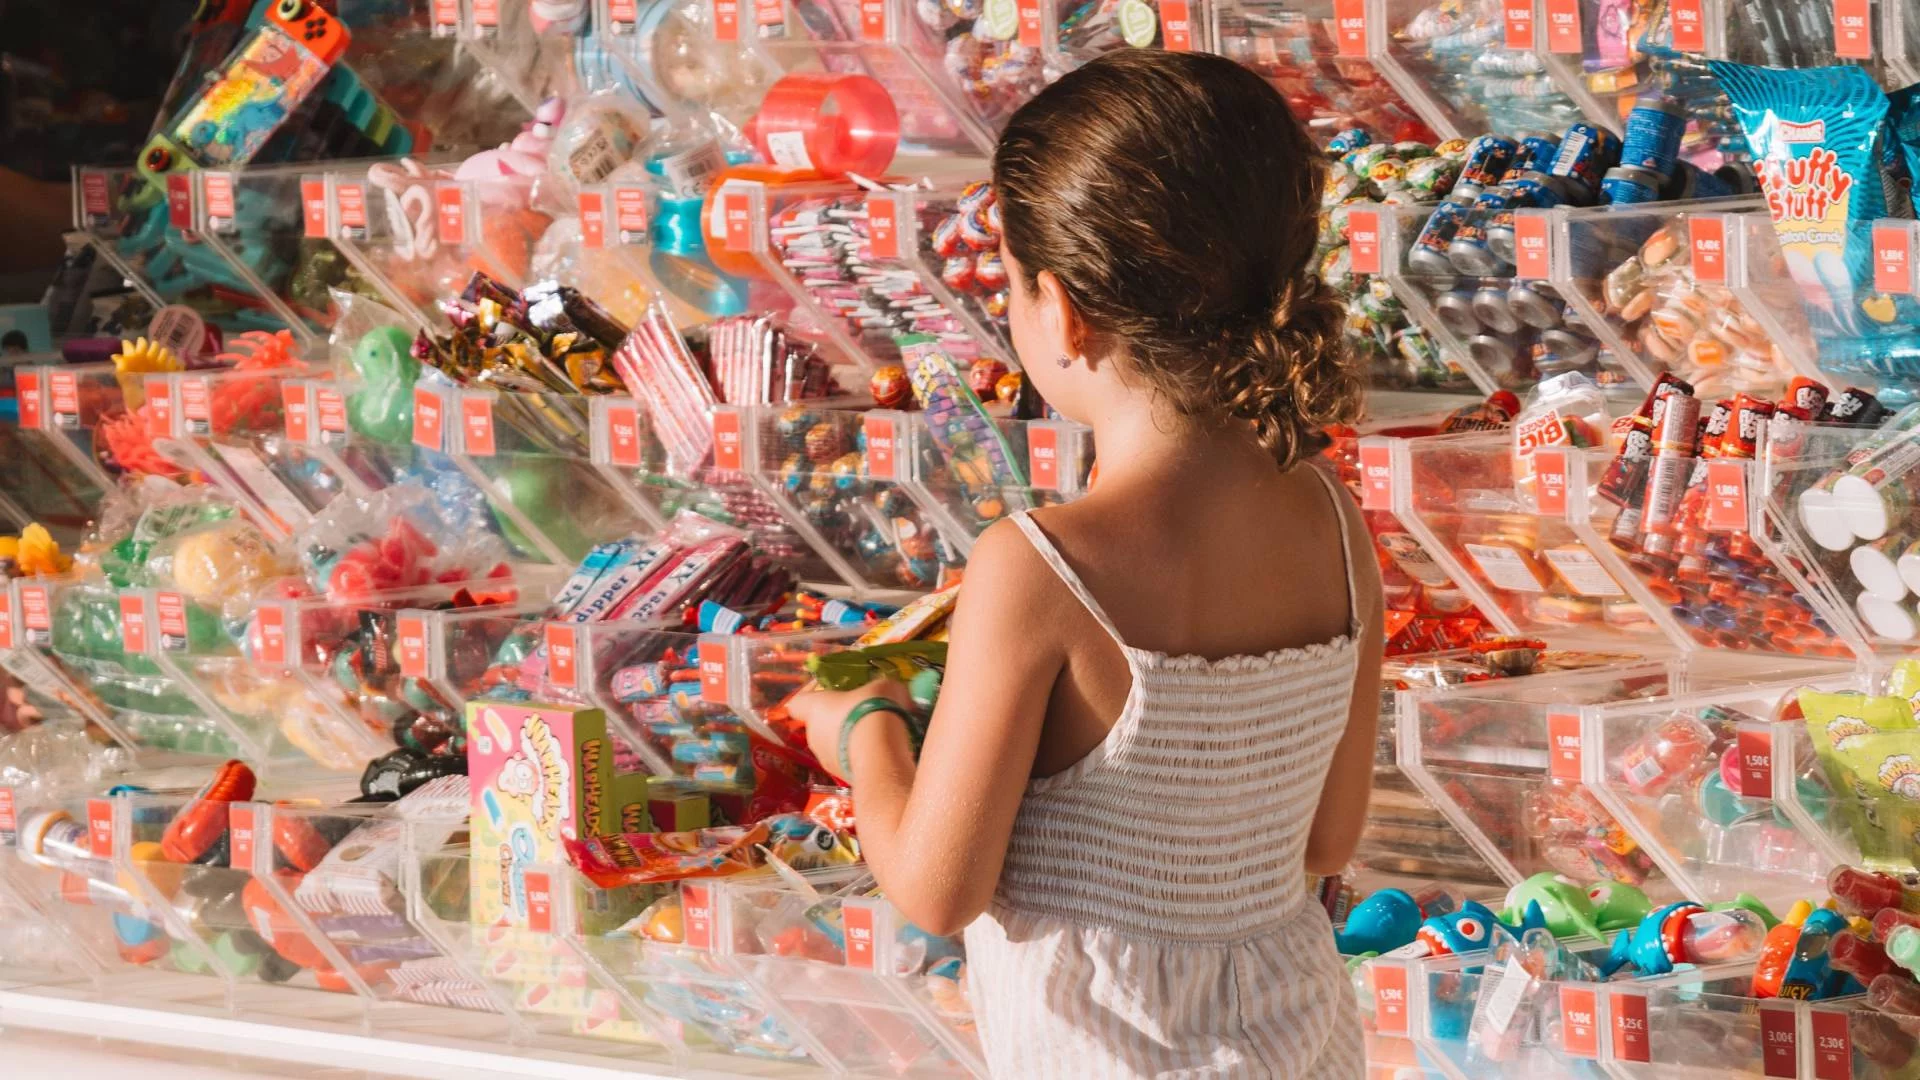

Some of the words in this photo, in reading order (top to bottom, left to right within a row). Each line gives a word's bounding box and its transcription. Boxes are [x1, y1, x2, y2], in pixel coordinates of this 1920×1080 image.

[1768, 187, 1828, 221] Stuff
[1519, 409, 1556, 437] BURGER
[1519, 420, 1564, 457] BIG
[575, 574, 630, 622] dipper
[1746, 755, 1769, 766] 1,50€
[526, 713, 563, 843] WARHEADS
[582, 738, 603, 842] WARHEADS
[1380, 989, 1402, 1000] 1,50€
[1617, 1016, 1642, 1030] 3,25€
[1769, 1031, 1793, 1042] 3,00€
[1820, 1037, 1844, 1049] 2,30€
